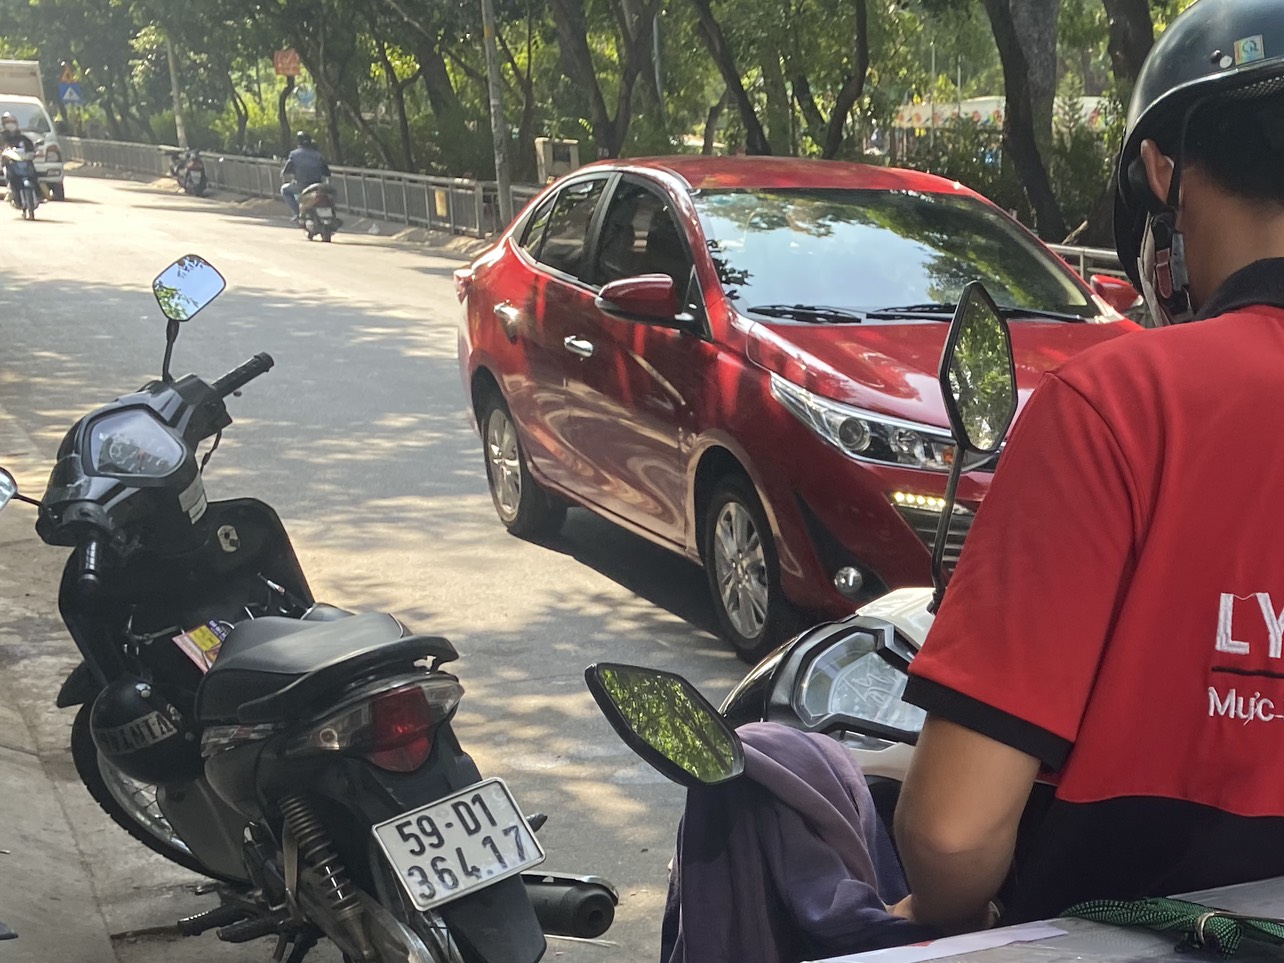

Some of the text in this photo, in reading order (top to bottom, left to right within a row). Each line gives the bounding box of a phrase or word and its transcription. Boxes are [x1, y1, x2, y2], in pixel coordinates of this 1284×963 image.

[1208, 687, 1275, 726] Mực
[395, 793, 498, 857] 59-D1
[407, 825, 526, 900] 364.17
